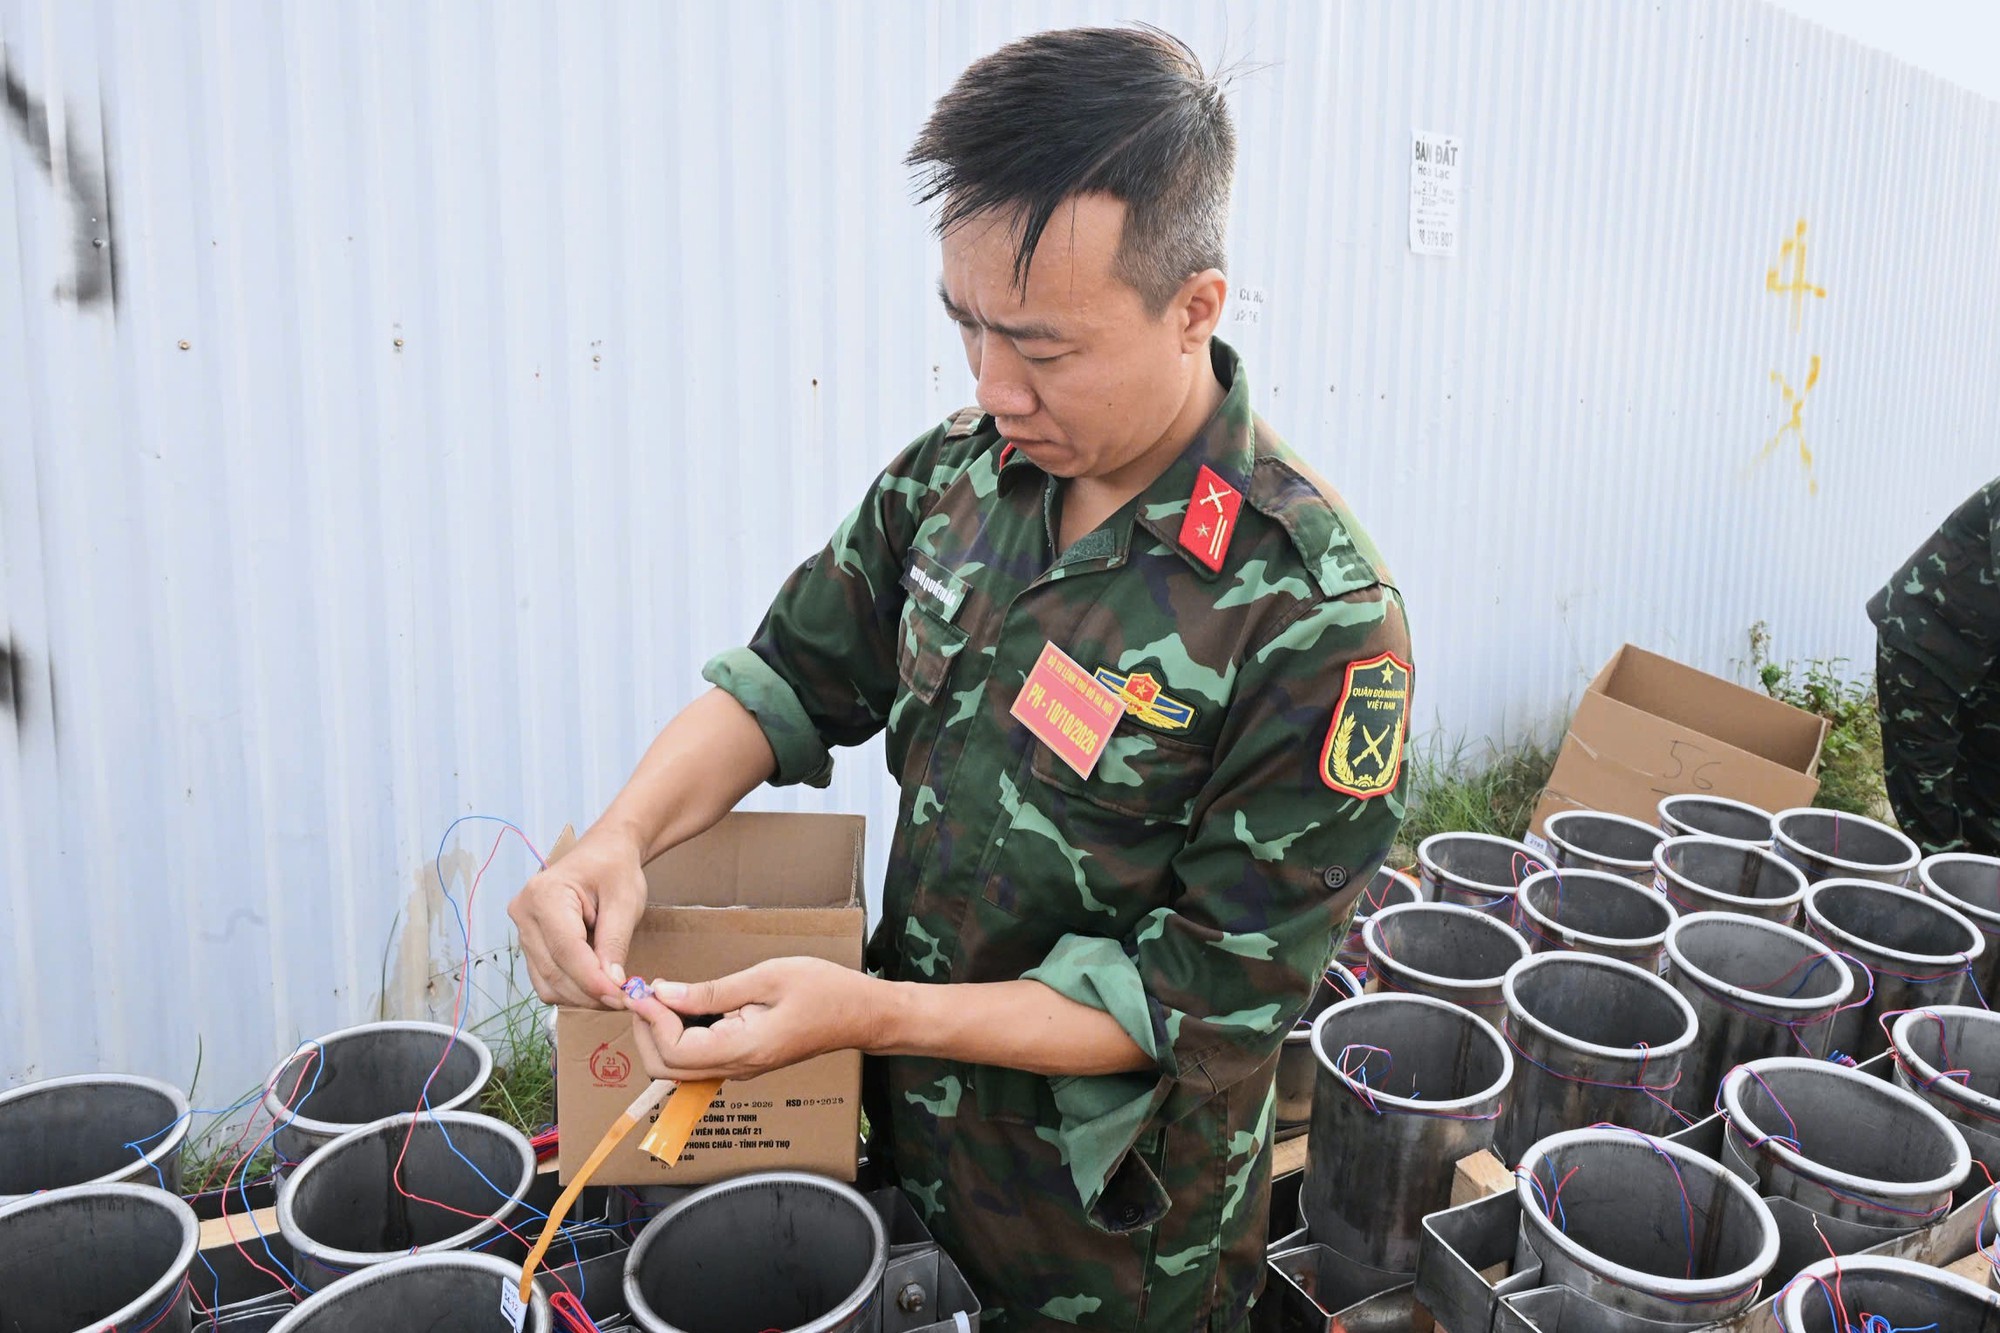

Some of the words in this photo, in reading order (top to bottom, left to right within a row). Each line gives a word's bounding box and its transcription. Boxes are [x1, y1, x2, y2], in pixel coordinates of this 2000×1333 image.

[1026, 682, 1047, 710] PH
[1352, 686, 1373, 697] QUÂN
[1367, 699, 1383, 711] VIỆT
[1663, 739, 1722, 790] 56
[606, 1056, 616, 1065] 21
[709, 1100, 725, 1108] NSX
[786, 1099, 801, 1107] HSD
[703, 1114, 725, 1123] CÔNG
[726, 1114, 735, 1122] TY
[737, 1114, 757, 1122] TNHH
[695, 1127, 713, 1136] VIÊN
[732, 1125, 751, 1135] CHẤT
[753, 1127, 762, 1135] 21
[684, 1141, 710, 1149] PHONG
[712, 1140, 733, 1149] CHÂU
[740, 1138, 757, 1148] TỈNH
[776, 1140, 790, 1149] THỌ
